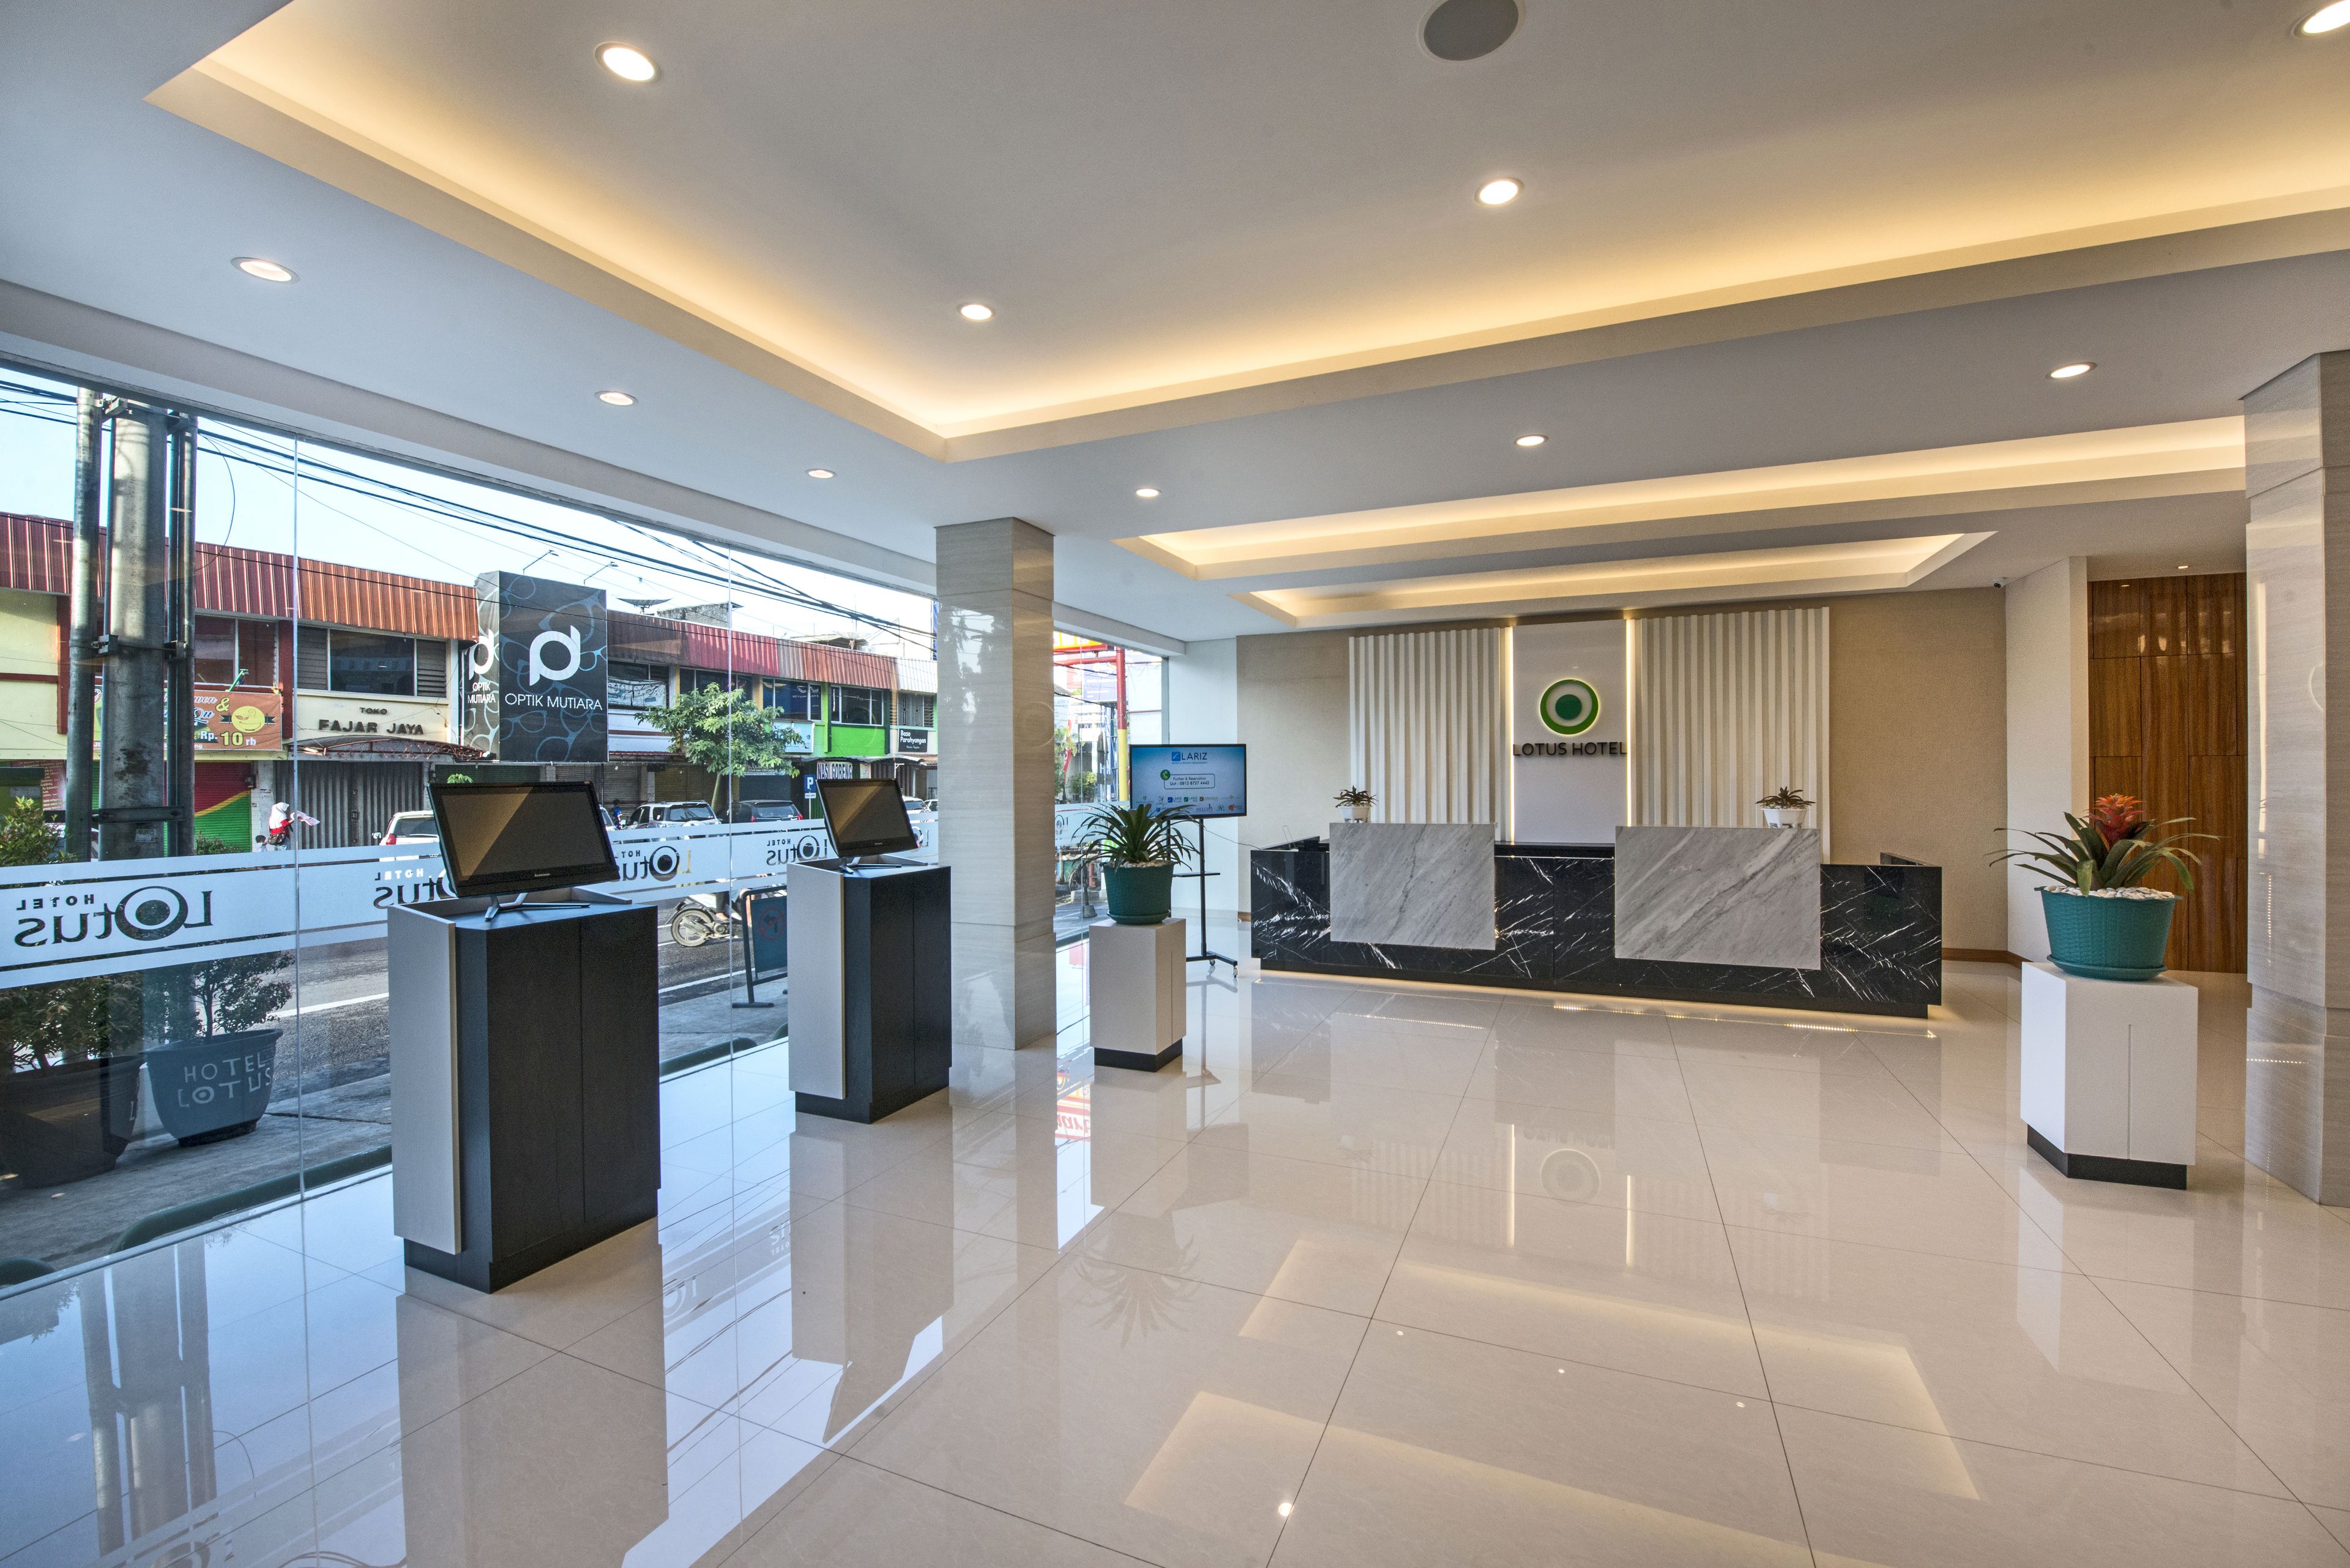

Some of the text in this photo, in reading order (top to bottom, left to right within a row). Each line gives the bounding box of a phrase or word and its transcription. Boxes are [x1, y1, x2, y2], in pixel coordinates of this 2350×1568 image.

[472, 682, 491, 692] OPTIK
[468, 693, 496, 704] MUTIARA
[505, 693, 603, 711] OPTIK MUTIARA
[318, 719, 424, 734] FAJAR JAYA
[200, 730, 218, 741] Rp.
[220, 731, 244, 746] 10
[245, 737, 257, 746] rb
[900, 736, 927, 745] Parahyangan
[1513, 742, 1628, 756] LOTUS HOTEL
[818, 763, 830, 779] NASI
[832, 763, 853, 779] GORENG
[807, 777, 814, 790] P
[184, 1053, 266, 1083] HOTEL
[177, 1067, 272, 1107] LOTUS
